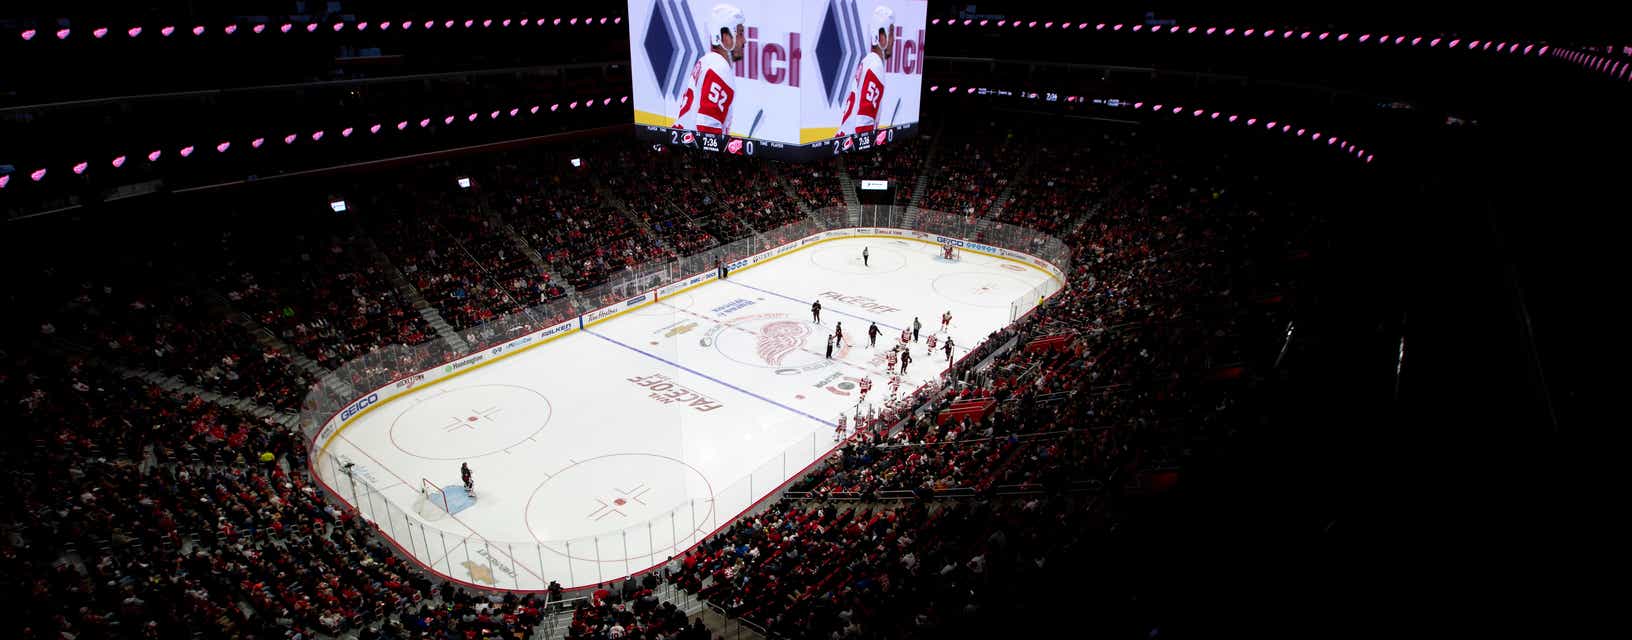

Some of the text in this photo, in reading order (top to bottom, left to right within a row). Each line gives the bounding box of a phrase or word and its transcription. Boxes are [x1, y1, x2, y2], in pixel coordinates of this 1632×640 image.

[708, 82, 728, 112] 52
[866, 81, 880, 109] 52
[671, 131, 678, 144] 2
[702, 137, 718, 148] 7:36
[858, 136, 871, 147] 7:36
[887, 129, 894, 142] 0
[746, 141, 754, 155] 0
[833, 140, 840, 154] 2
[340, 393, 378, 421] GEICO
